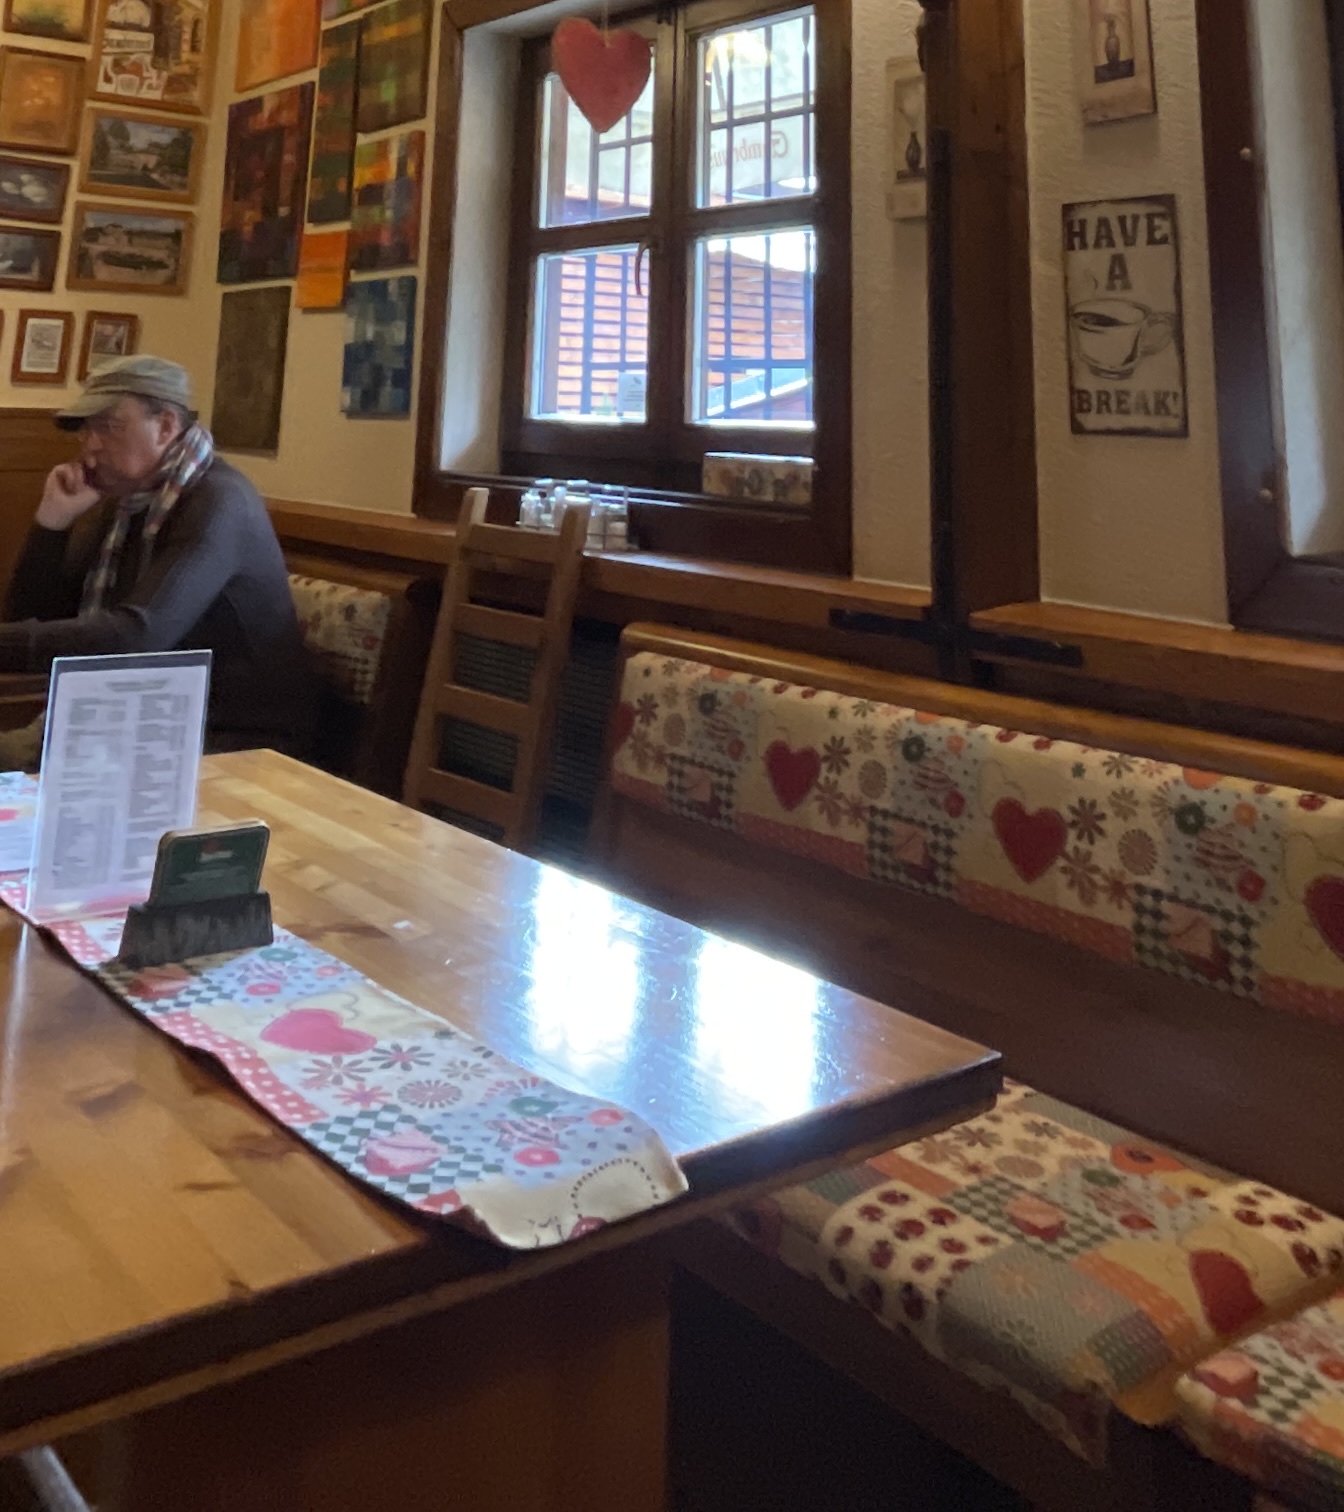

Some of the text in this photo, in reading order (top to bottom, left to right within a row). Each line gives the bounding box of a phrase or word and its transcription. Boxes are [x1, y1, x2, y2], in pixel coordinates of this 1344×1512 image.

[1066, 211, 1170, 251] HAVE
[1106, 253, 1133, 291] A
[1074, 389, 1180, 419] BREAK!
